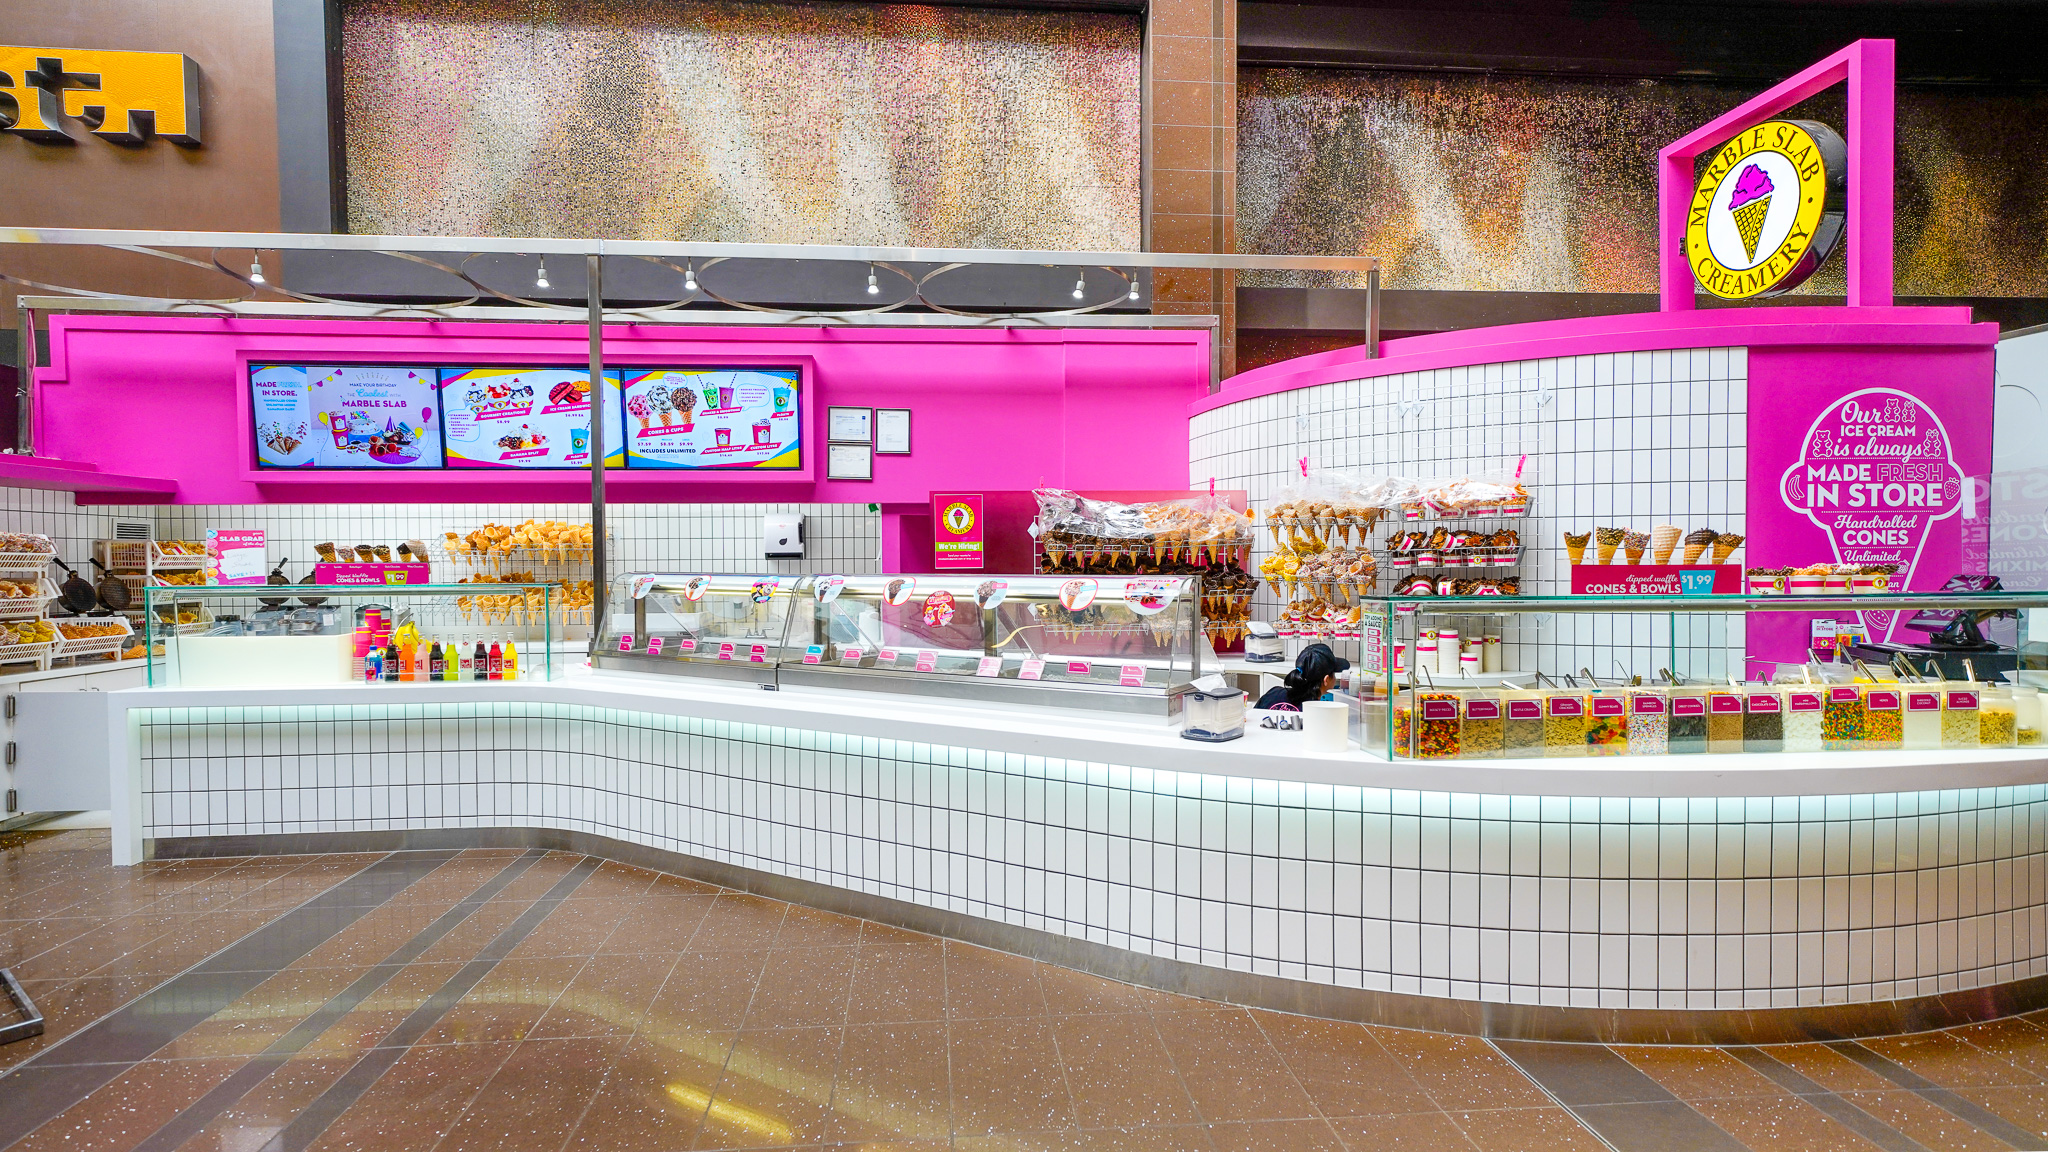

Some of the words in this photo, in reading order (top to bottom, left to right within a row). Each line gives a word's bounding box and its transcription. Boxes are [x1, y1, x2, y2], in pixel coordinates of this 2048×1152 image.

[1690, 127, 1766, 228] MARBLE
[1772, 125, 1820, 182] SLAB
[1697, 221, 1810, 295] CREAMERY
[355, 388, 389, 398] Coolest
[342, 400, 381, 408] MARBLE
[383, 400, 407, 408] SLAB
[1841, 400, 1884, 424] Our
[1840, 425, 1863, 437] ICE
[1867, 425, 1916, 437] CREAM
[1834, 438, 1850, 457] is
[1854, 437, 1923, 463] always
[1807, 464, 1872, 482] MADE
[1876, 463, 1943, 482] FRESH
[1807, 483, 1839, 507] IN
[1848, 483, 1943, 507] STORE
[1834, 514, 1918, 529] Handrolled
[1842, 529, 1909, 546] CONES
[1843, 549, 1901, 562] Unlimited
[387, 573, 405, 582] $1.99
[1625, 574, 1653, 584] dipped
[1653, 574, 1679, 585] waffle
[1681, 574, 1712, 590] $1.99
[1585, 584, 1629, 594] CONES
[1630, 584, 1638, 594] &
[1640, 584, 1681, 594] BOWLS
